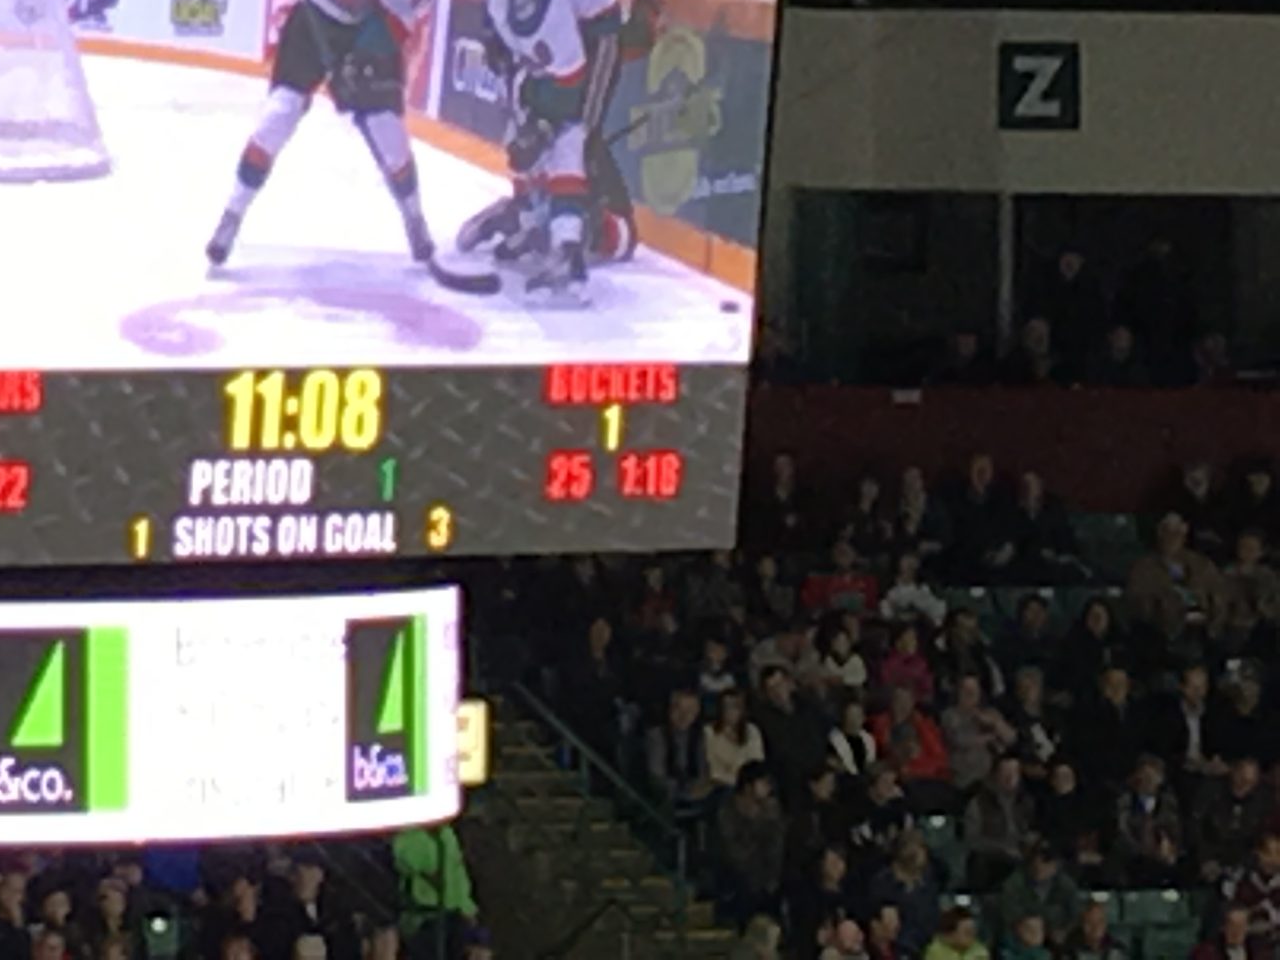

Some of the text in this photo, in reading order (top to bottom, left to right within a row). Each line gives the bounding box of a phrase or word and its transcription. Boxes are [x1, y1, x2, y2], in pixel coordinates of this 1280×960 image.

[1012, 55, 1064, 118] Z
[225, 369, 382, 451] 11:08
[603, 403, 621, 451] 1
[189, 458, 397, 505] PERIOD 1
[545, 454, 591, 501] 25
[132, 506, 451, 558] 1 SHOTS ON GOAL 3
